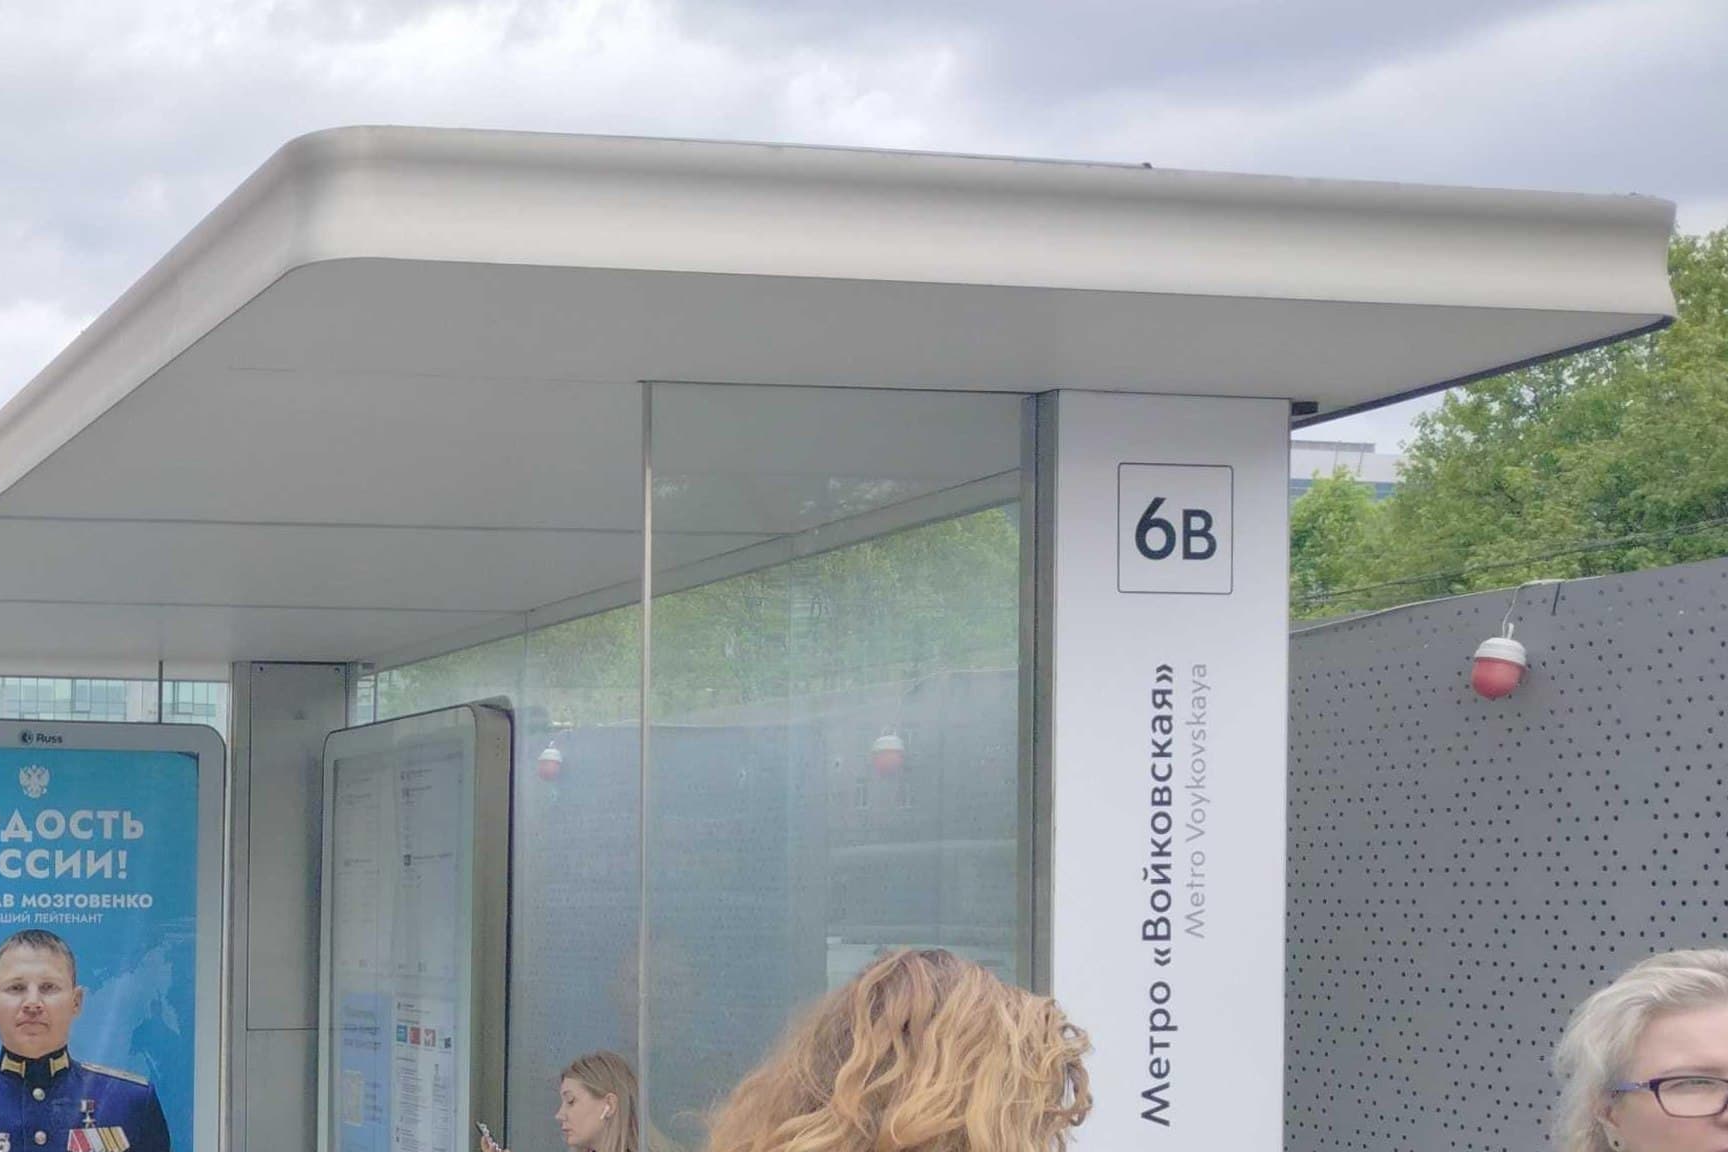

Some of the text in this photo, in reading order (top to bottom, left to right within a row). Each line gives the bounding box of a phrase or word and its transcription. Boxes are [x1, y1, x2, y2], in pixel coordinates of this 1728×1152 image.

[1184, 663, 1212, 939] Metro Voykovskaya
[22, 893, 153, 908] МОЗГОВЕНКО
[34, 912, 104, 923] ЛЕЙТЕНАНТ
[1140, 663, 1178, 1128] Метро «Войковская»
